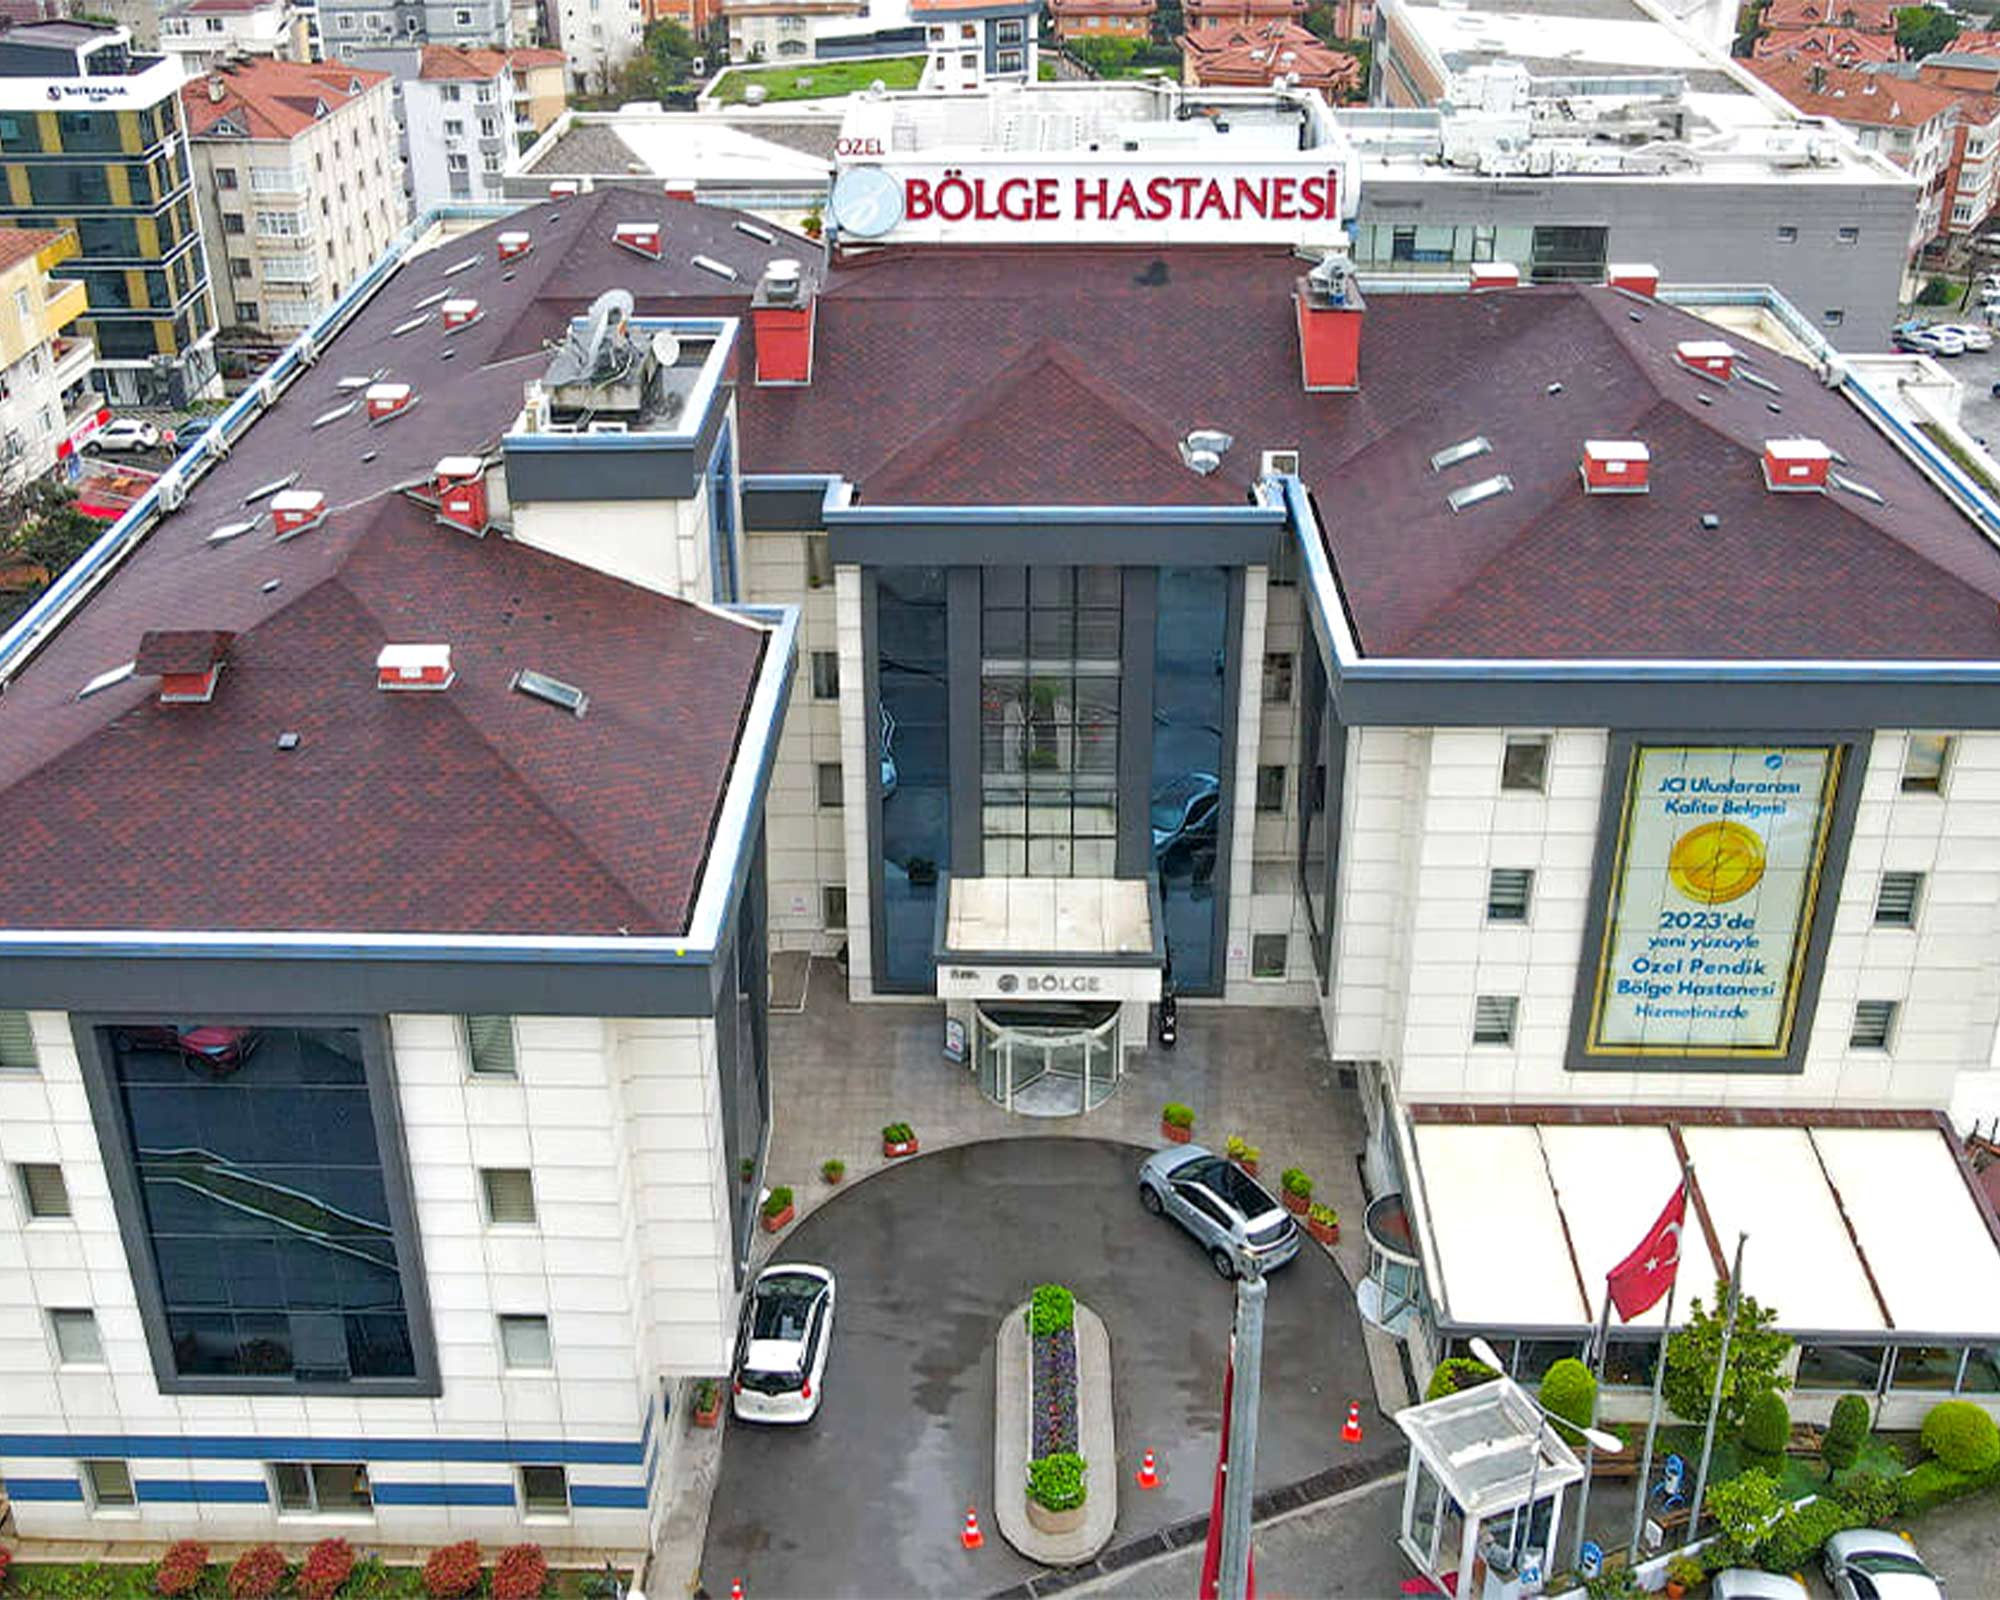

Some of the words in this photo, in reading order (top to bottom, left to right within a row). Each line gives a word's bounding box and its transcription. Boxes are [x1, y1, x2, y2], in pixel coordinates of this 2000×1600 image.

[904, 169, 1061, 222] BÖLGE
[1074, 169, 1337, 221] HASTANESİ
[1660, 911, 1756, 930] 2023'de
[1689, 958, 1766, 975] Pendik
[1677, 980, 1776, 996] Hastanesi
